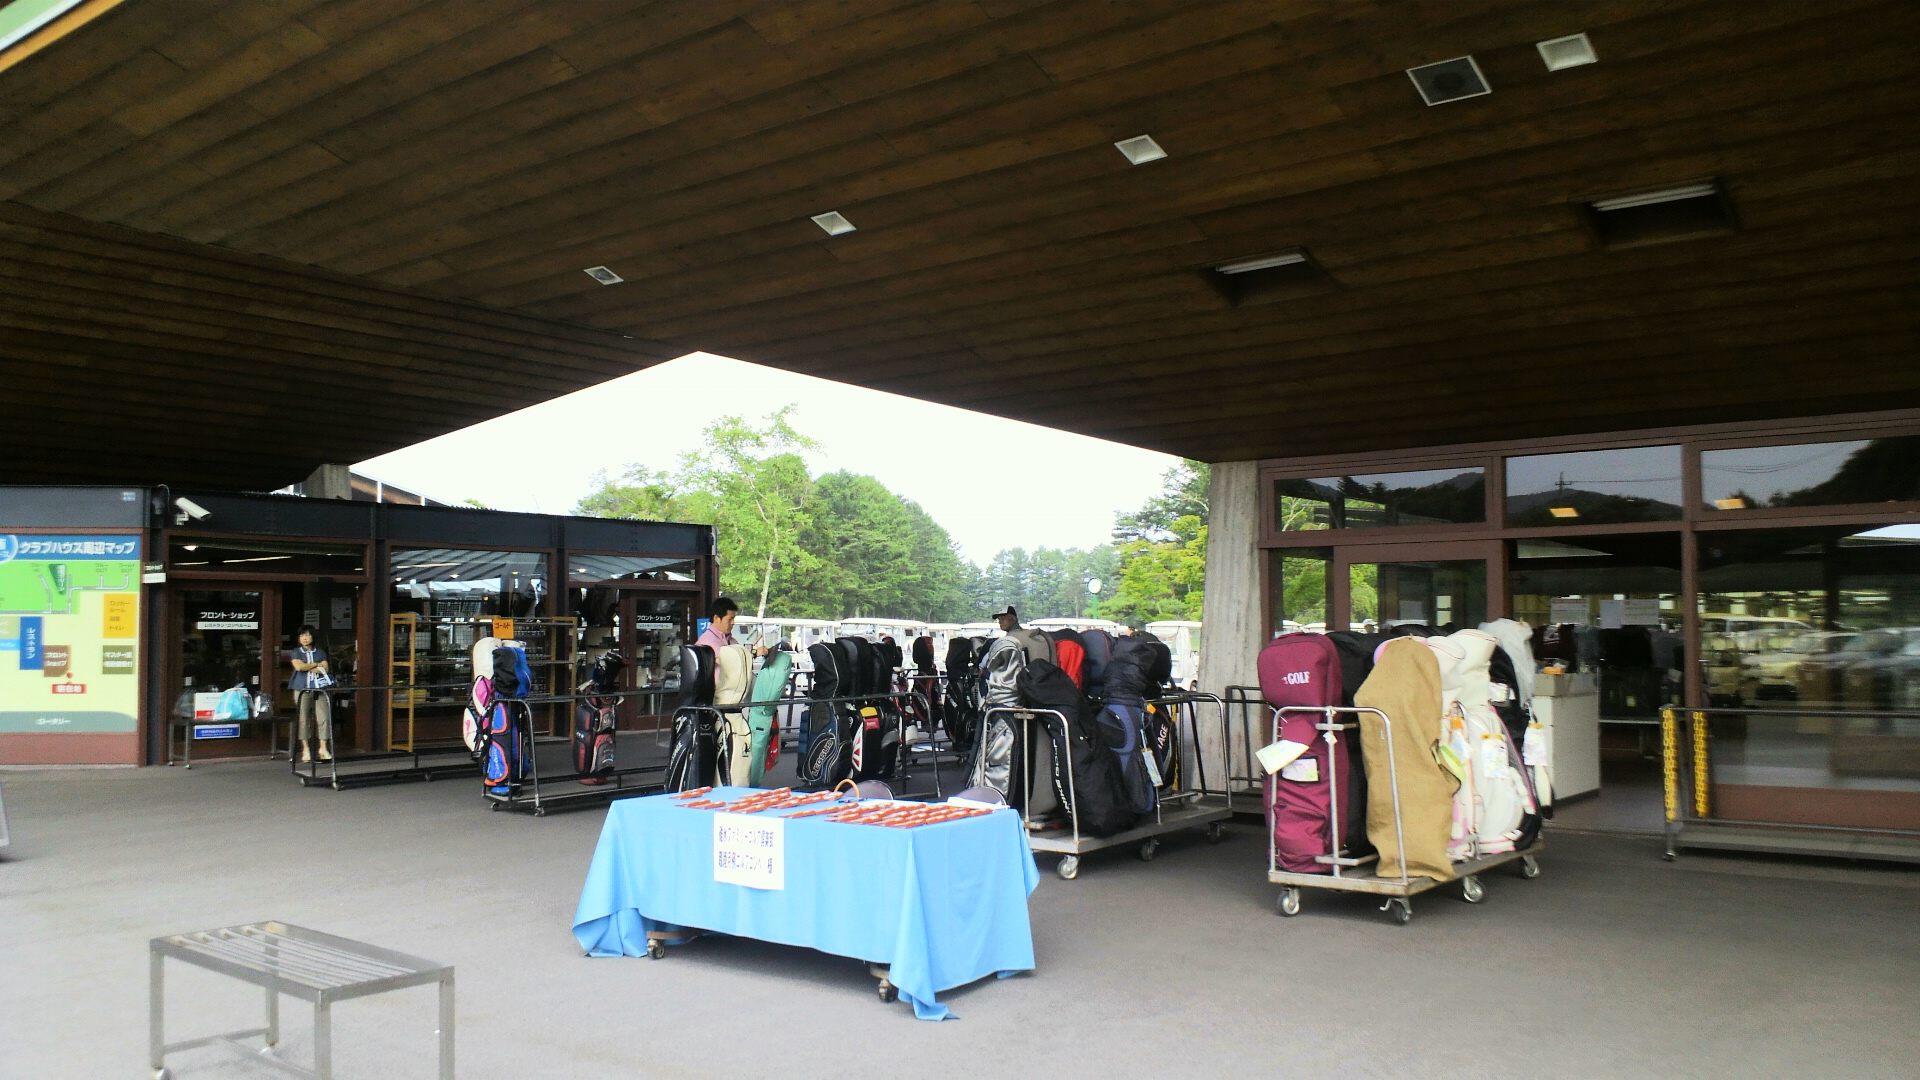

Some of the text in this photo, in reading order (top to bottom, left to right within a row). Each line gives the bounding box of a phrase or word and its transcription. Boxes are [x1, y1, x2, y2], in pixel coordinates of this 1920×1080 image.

[19, 541, 136, 555] クラブハウス周辺マップ
